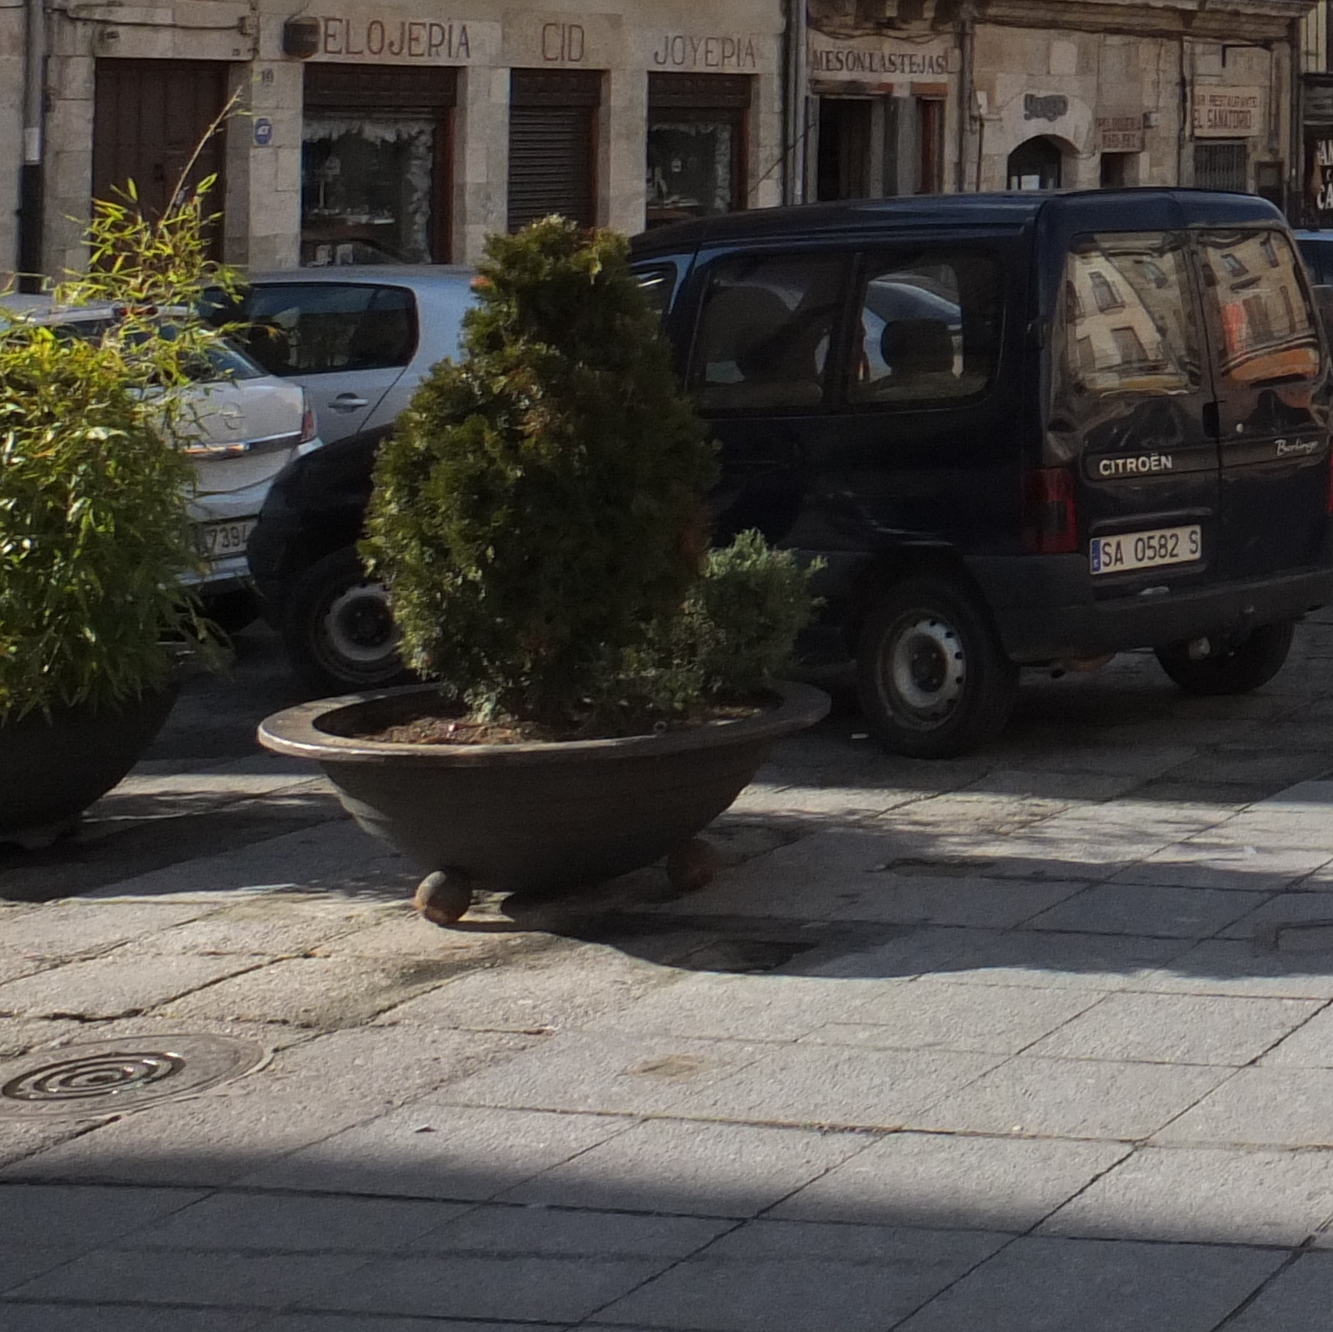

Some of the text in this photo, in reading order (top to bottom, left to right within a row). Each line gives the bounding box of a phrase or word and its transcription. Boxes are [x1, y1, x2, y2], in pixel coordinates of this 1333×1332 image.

[316, 18, 471, 59] ELOJERIA
[541, 22, 585, 63] CID
[868, 51, 898, 73] LAS
[898, 53, 945, 75] TEJAS
[1207, 109, 1252, 130] SANATORIO
[1274, 438, 1319, 457] Berlingo
[1099, 452, 1173, 476] CITROËN
[1102, 530, 1199, 567] SA 0582 S
